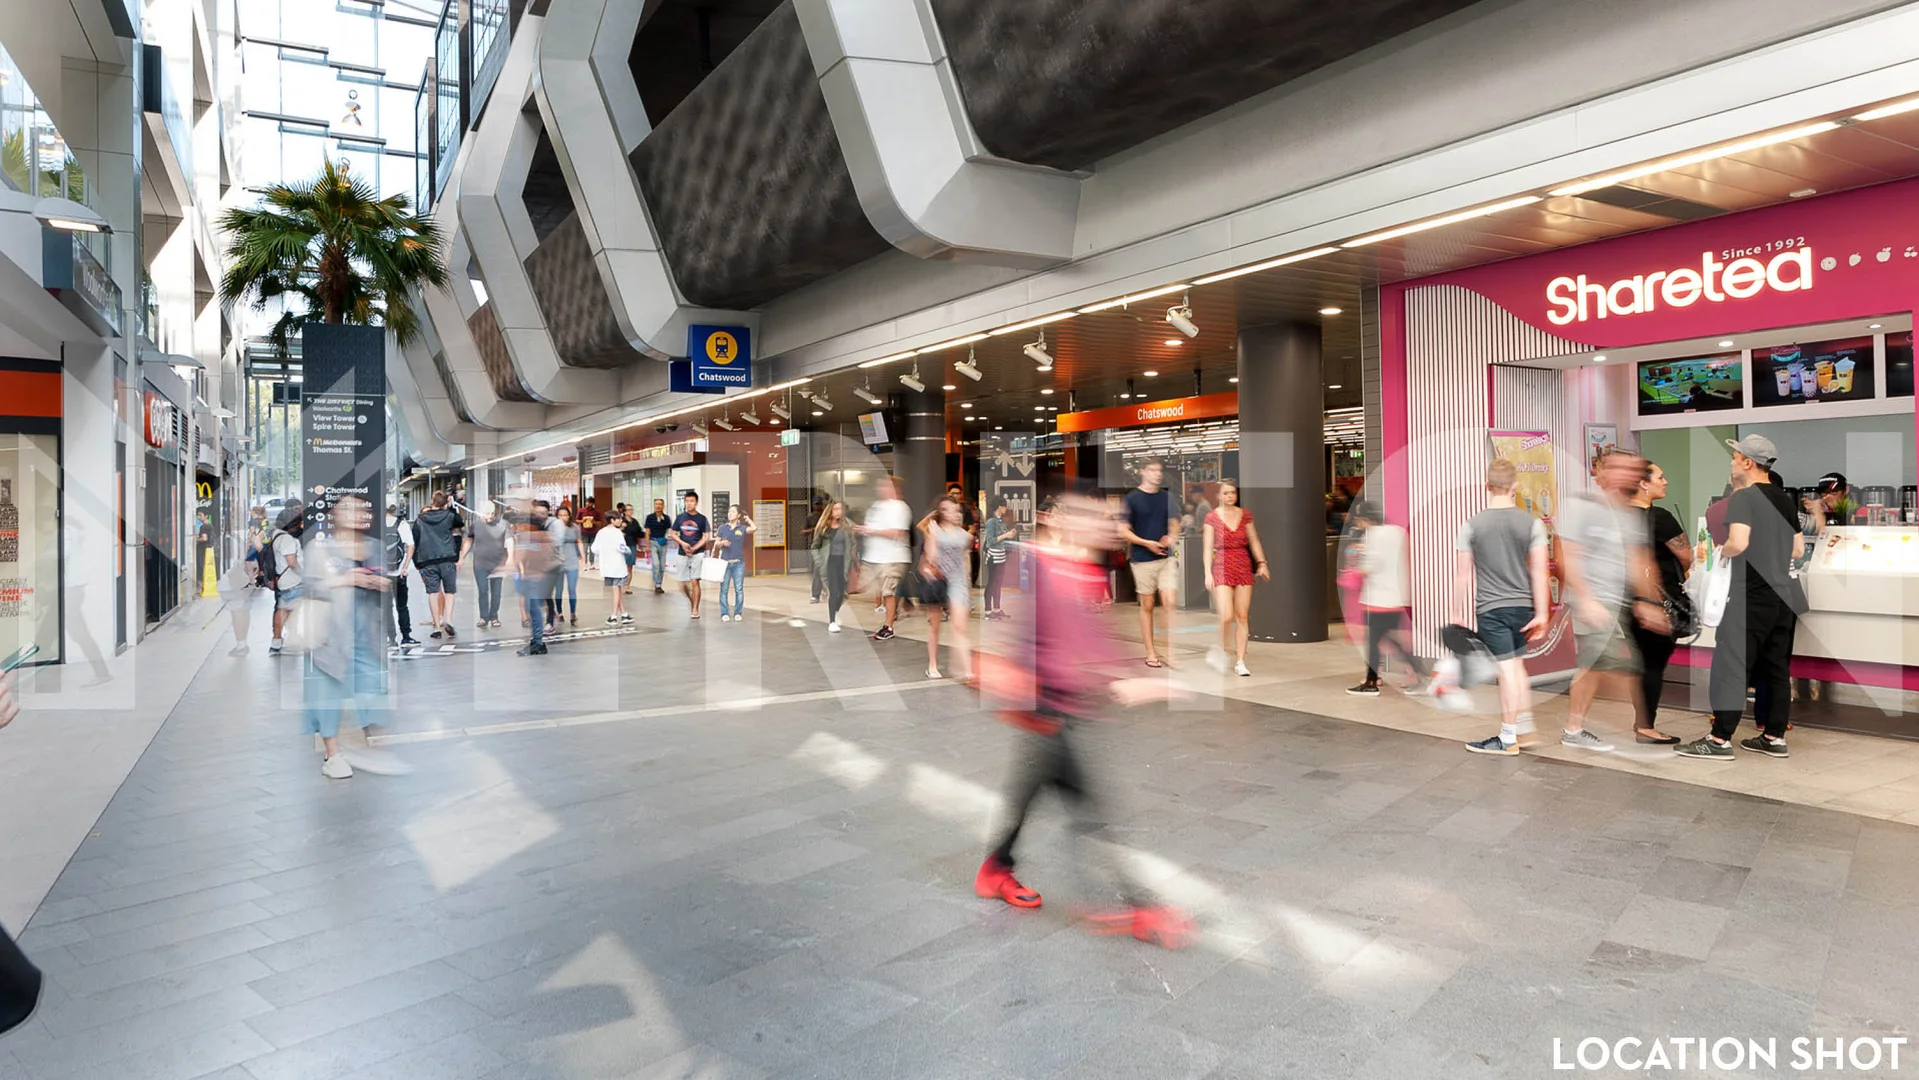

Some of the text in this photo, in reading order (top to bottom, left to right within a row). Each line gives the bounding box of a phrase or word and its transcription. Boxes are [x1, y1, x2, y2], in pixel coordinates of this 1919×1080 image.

[1721, 236, 1806, 260] Since 1992
[1546, 246, 1813, 326] Sharetea
[698, 372, 746, 382] Chatswood
[312, 414, 332, 422] View
[1137, 403, 1184, 420] Chatswood
[312, 423, 356, 431] Spire Tower
